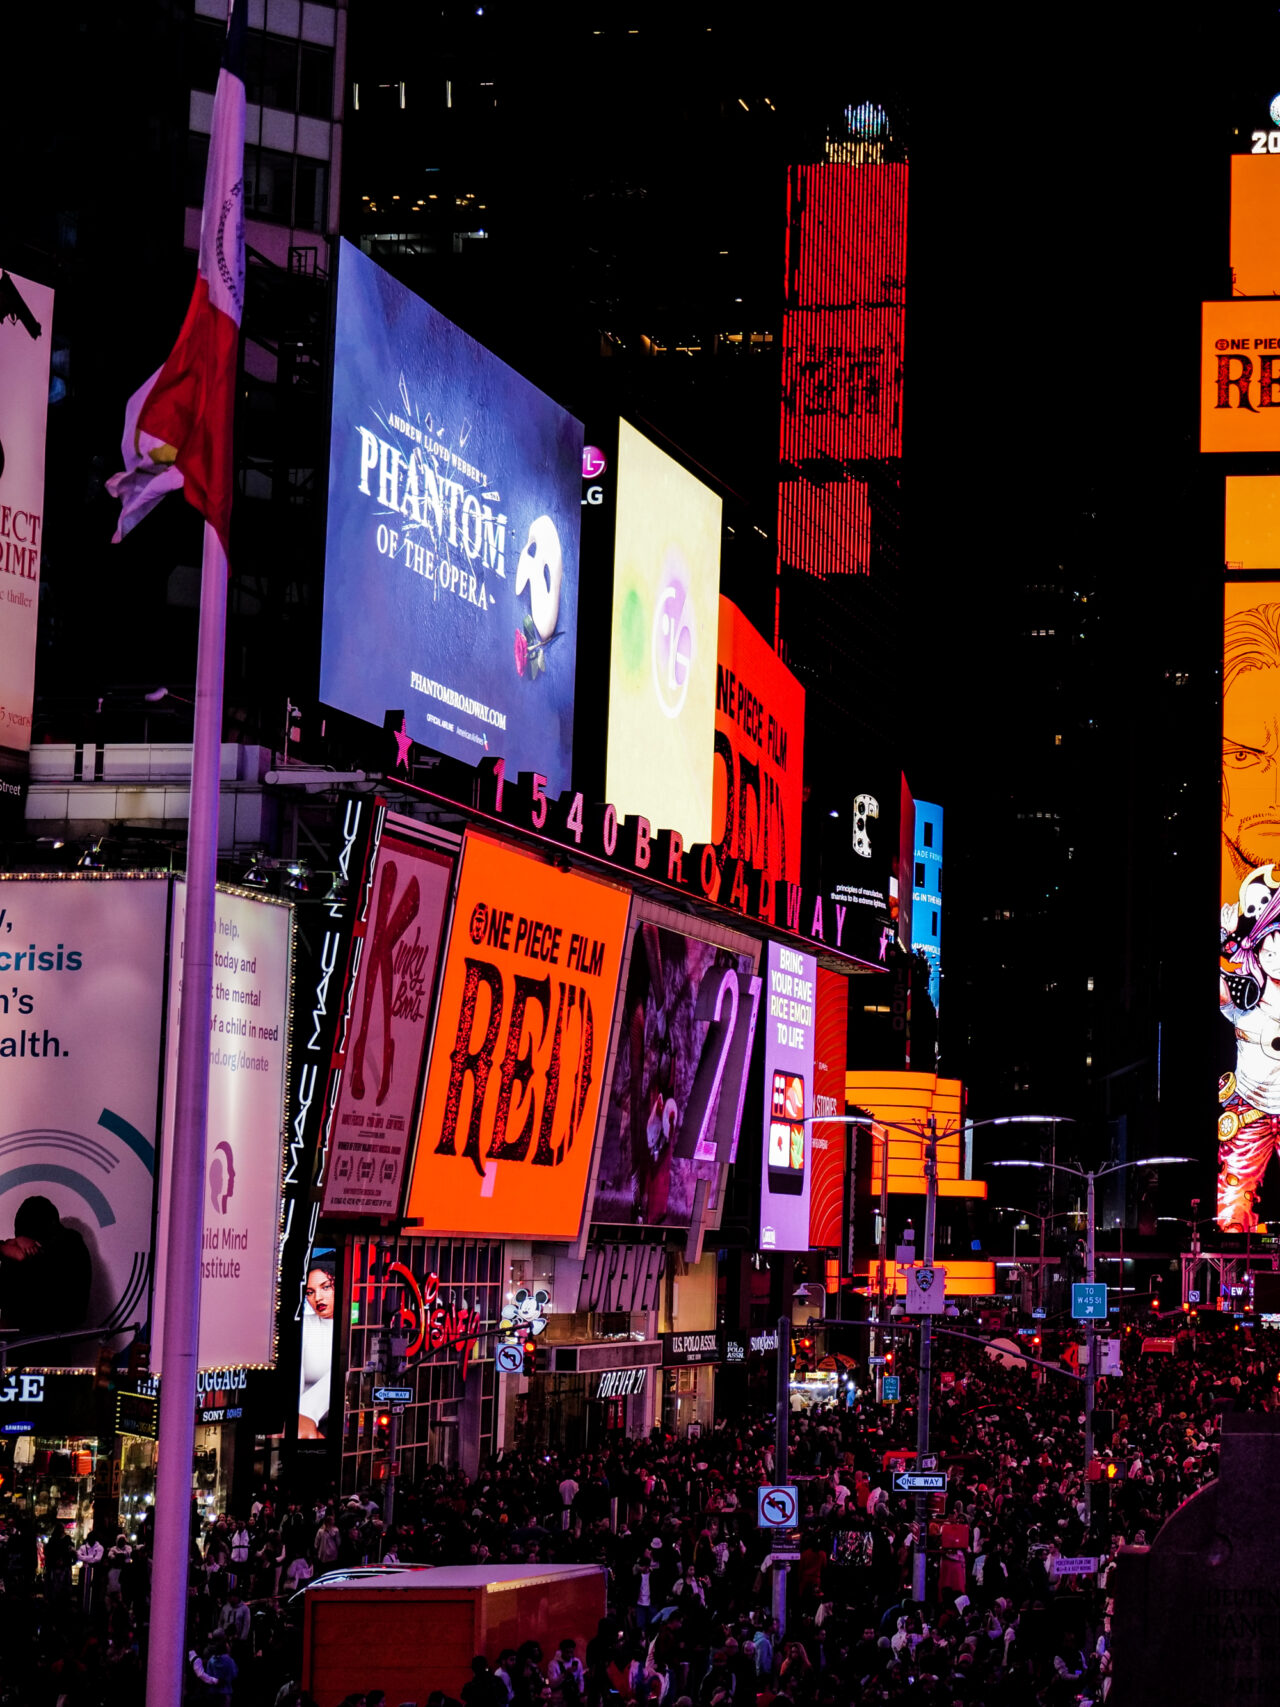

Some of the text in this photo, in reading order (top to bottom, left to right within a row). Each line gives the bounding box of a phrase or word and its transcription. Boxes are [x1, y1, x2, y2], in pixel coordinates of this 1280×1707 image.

[388, 412, 487, 487] ANDREW LLOYD WEBBER'S
[355, 426, 507, 579] PHANTOM
[376, 524, 488, 611] OF THE OPERA
[7, 589, 32, 608] thriller
[410, 671, 507, 730] PHANTOMBROADWAY.COM
[717, 663, 787, 772] NE PIECE FILM
[493, 757, 846, 947] 1540 BROADWAY
[218, 919, 240, 939] help.
[0, 944, 83, 971] crisis
[514, 917, 562, 964] PIECE
[567, 934, 605, 977] FILM
[215, 953, 257, 976] today and
[780, 948, 803, 975] BRING
[216, 984, 261, 1007] the mental
[772, 970, 812, 1002] YOUR FAVE
[771, 995, 811, 1027] RICE EMOJI
[219, 1017, 279, 1042] a child in need
[777, 1023, 804, 1050] TO LIFE
[434, 957, 593, 1177] RED
[694, 969, 762, 1164] 21
[222, 1228, 248, 1250] Mind
[201, 1257, 241, 1279] nstitute
[1085, 1287, 1095, 1295] TO
[684, 1336, 699, 1352] POLO
[197, 1369, 247, 1391] UGGAGE
[597, 1369, 647, 1399] FOREVER 21
[203, 1410, 224, 1422] SONY
[901, 1476, 939, 1486] ONE WAY
